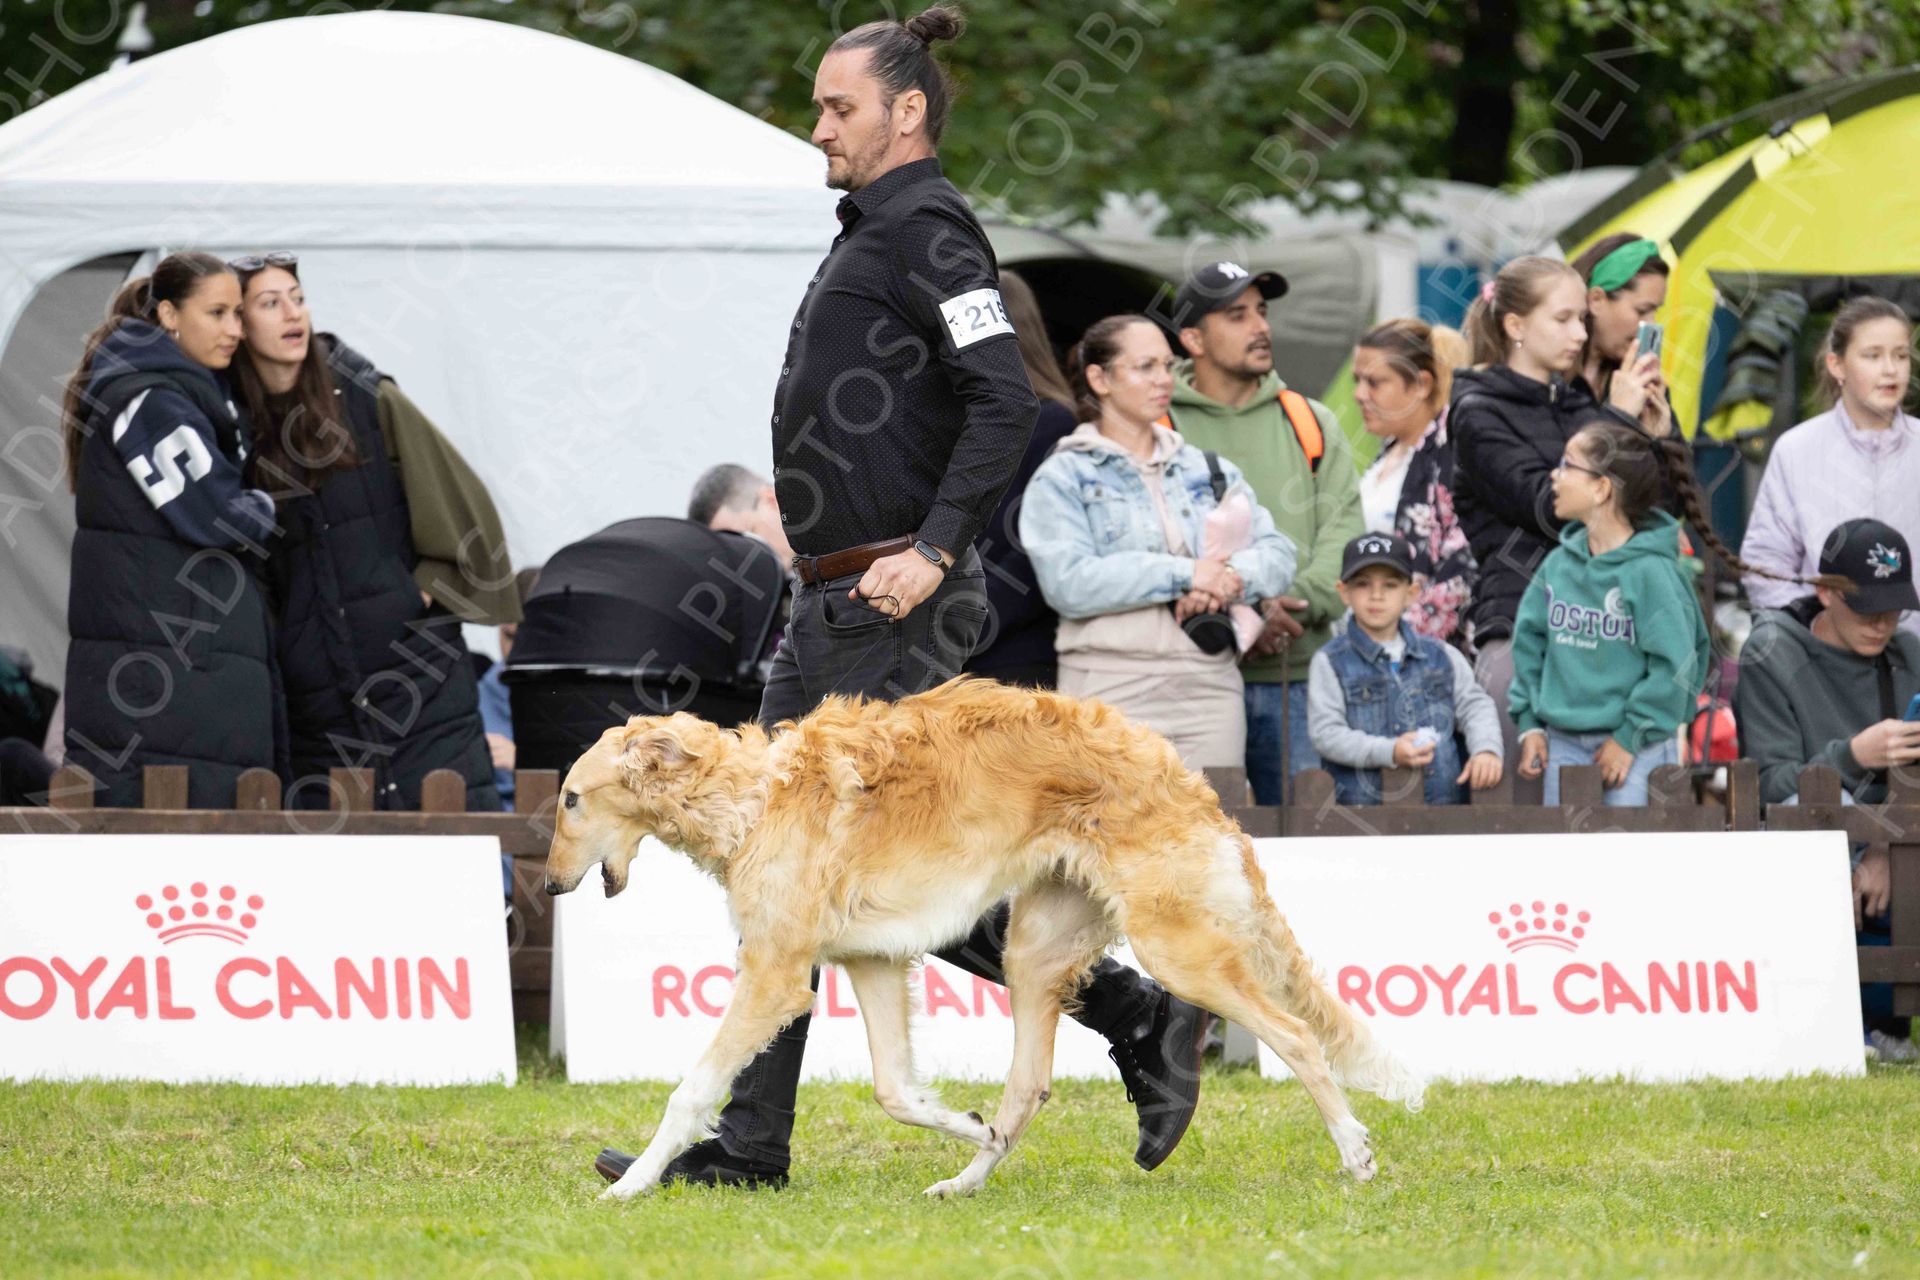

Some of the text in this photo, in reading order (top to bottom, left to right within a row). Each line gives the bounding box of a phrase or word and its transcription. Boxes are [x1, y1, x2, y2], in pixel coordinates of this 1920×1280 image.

[215, 955, 471, 1021] CANIN
[652, 965, 857, 1019] ROL
[1337, 959, 1759, 1018] ROYAL CANIN
